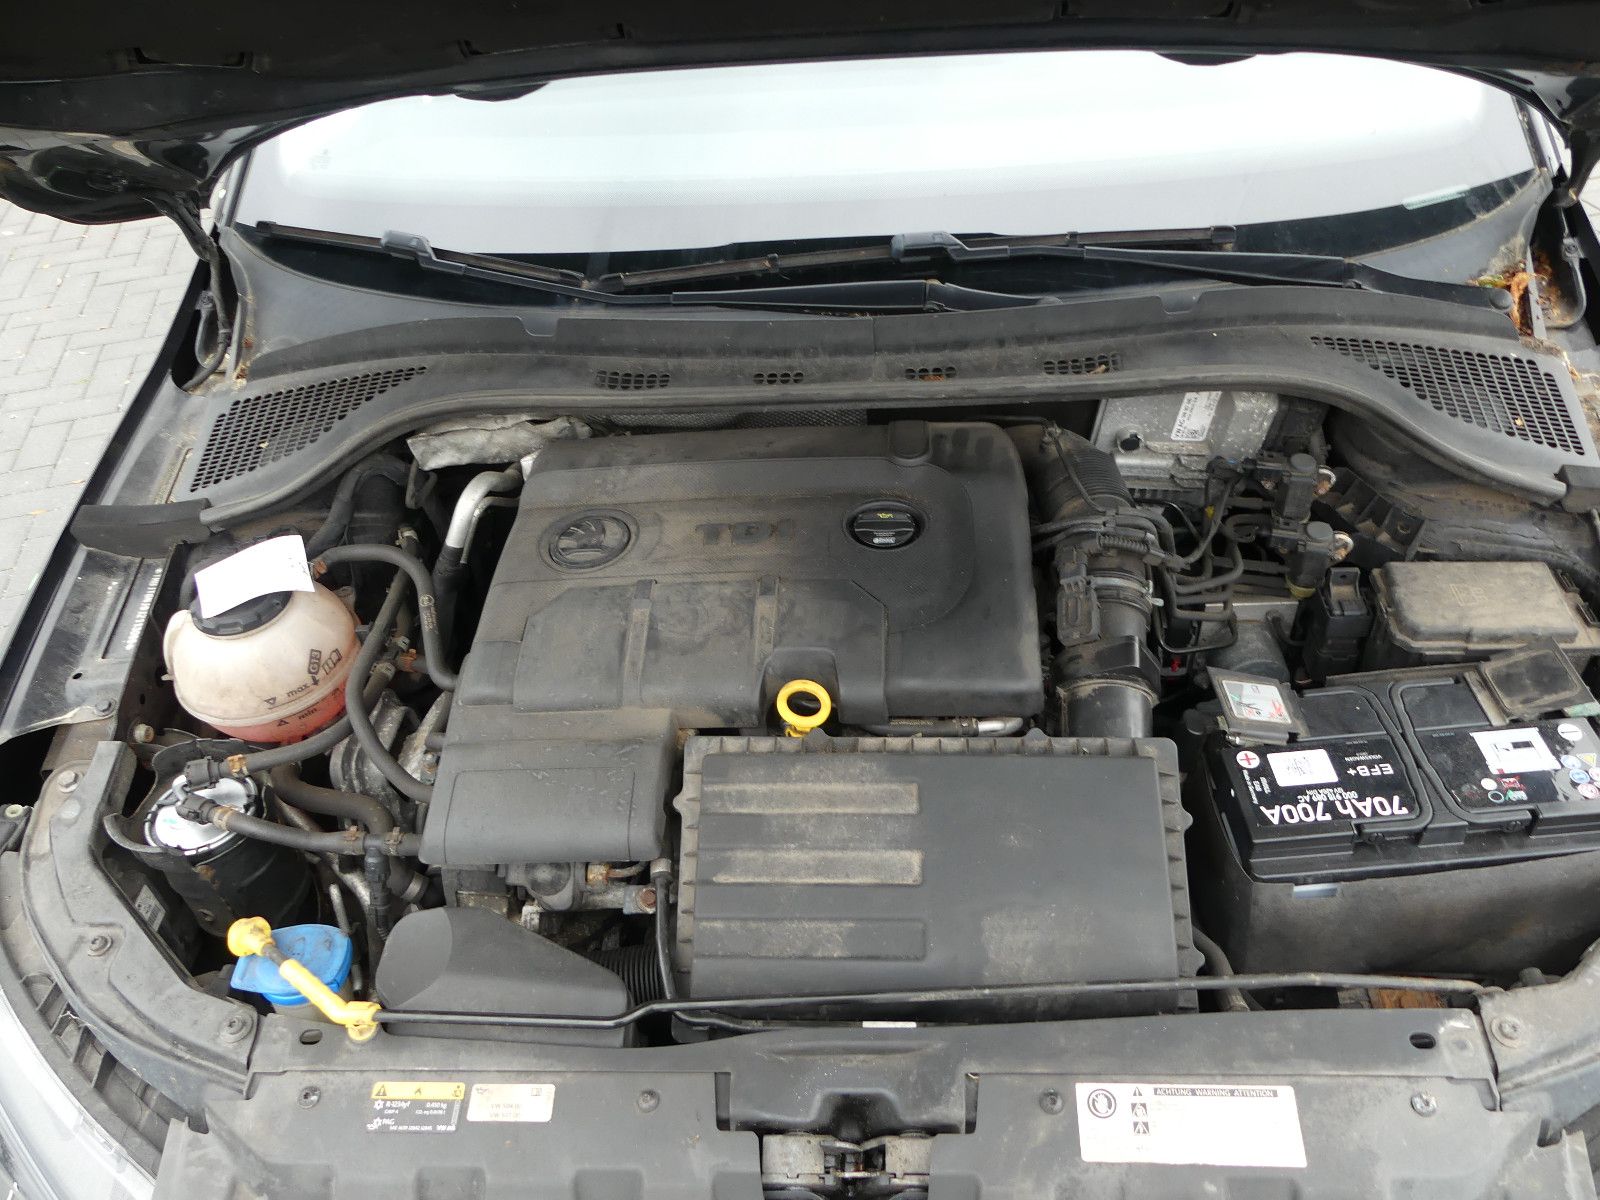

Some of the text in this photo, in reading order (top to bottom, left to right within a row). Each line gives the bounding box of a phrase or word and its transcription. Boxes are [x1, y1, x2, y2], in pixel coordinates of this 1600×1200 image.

[286, 683, 309, 697] max
[1347, 763, 1394, 777] EFB+
[1260, 795, 1409, 825] 70Ah 700A
[1157, 1088, 1273, 1097] ACHTUNG WARNING ATTENTION
